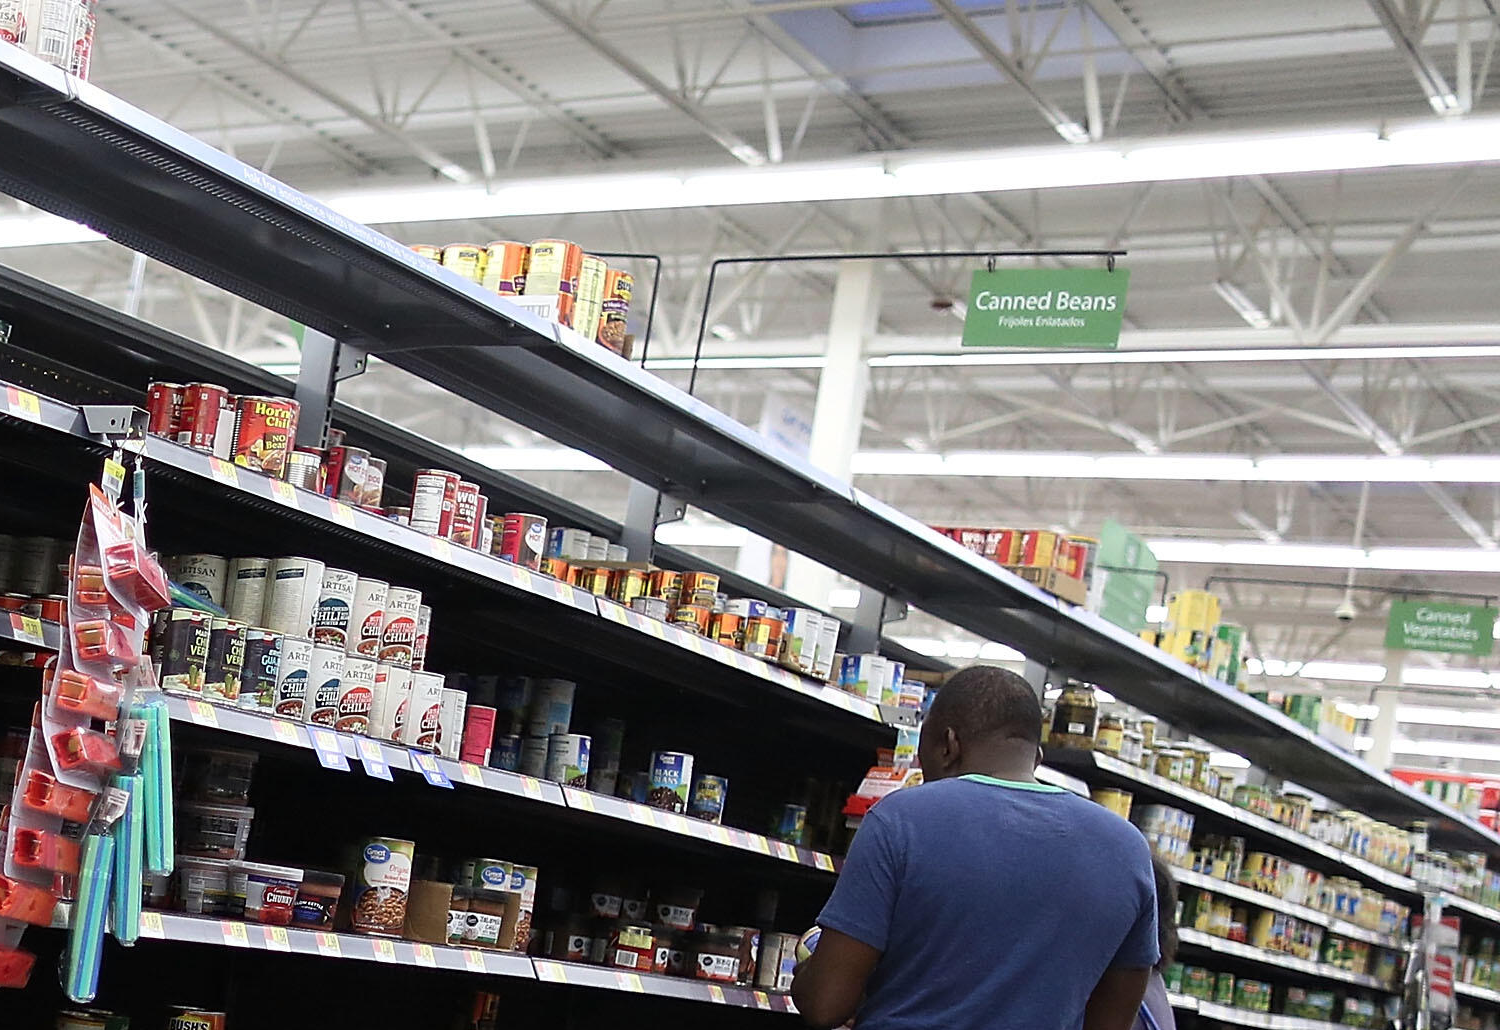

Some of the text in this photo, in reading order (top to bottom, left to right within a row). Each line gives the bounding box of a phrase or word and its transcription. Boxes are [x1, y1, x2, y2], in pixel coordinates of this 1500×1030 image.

[975, 290, 1117, 312] Canned Beans
[998, 315, 1086, 328] Frijoles Enlatados
[265, 416, 290, 428] Chil
[272, 434, 286, 443] NO
[1416, 606, 1471, 625] Canned
[361, 625, 382, 637] CHIL
[1403, 621, 1479, 641] Vegetables
[190, 644, 206, 657] VER
[225, 653, 244, 666] VER
[266, 892, 293, 907] CHUNKY
